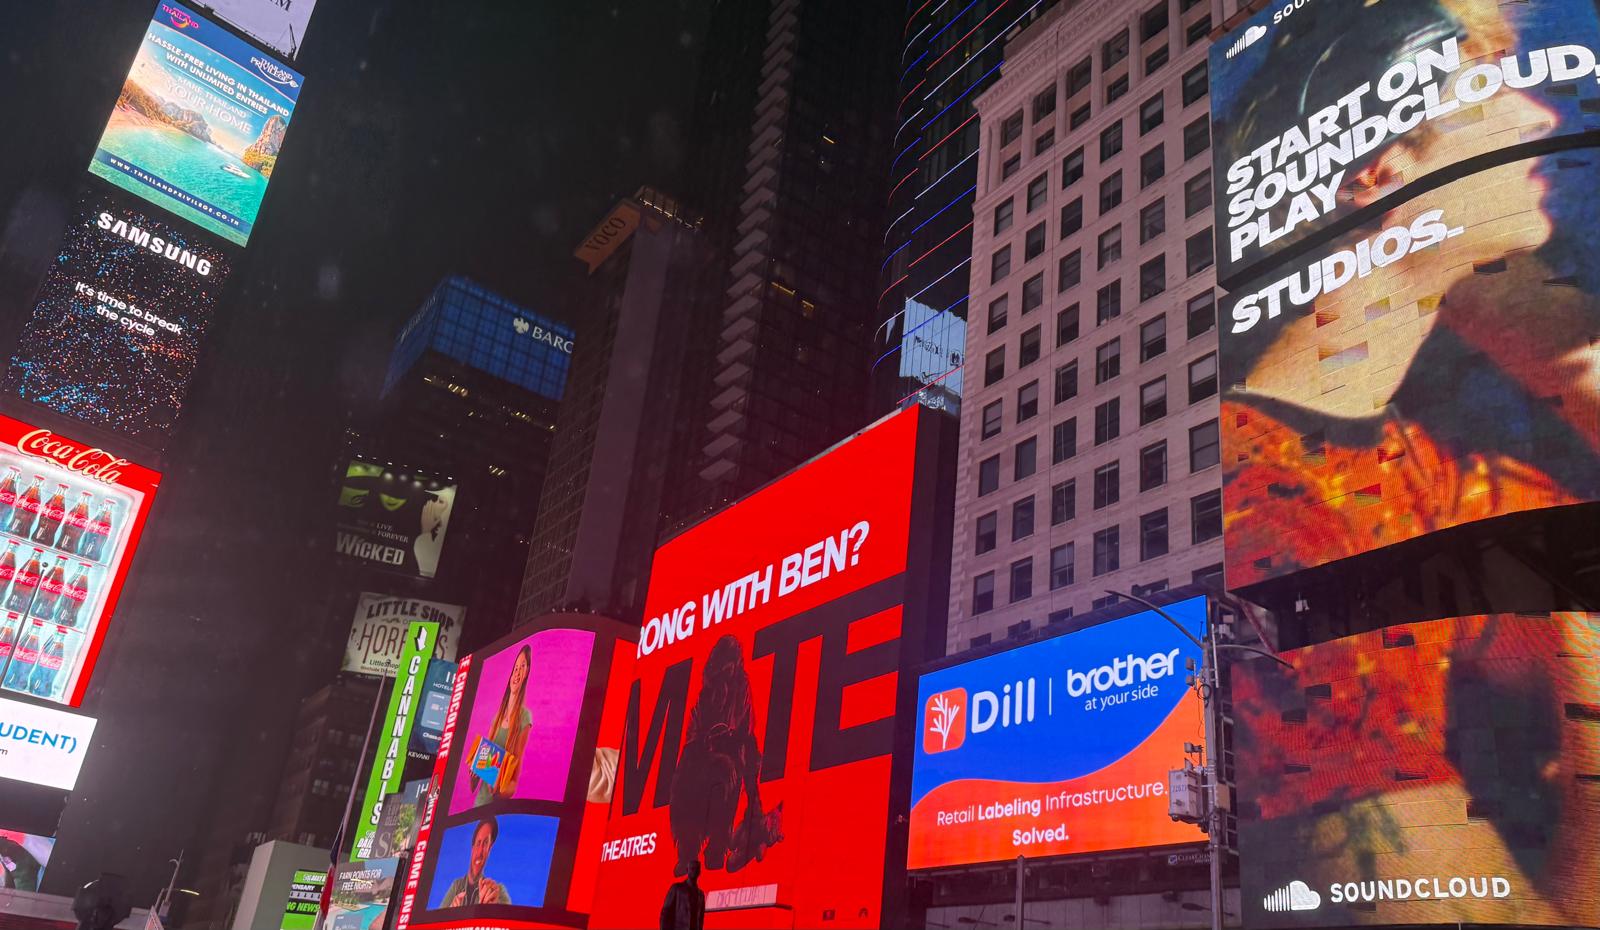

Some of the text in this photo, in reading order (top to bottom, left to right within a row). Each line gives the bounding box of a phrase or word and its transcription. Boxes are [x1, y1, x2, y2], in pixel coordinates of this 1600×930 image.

[1273, 0, 1310, 24] SOU
[148, 33, 290, 117] HASSLE-FREE LIVING IN THAILAND
[166, 53, 268, 115] WITH UNLIMITED ENTRIES
[208, 104, 253, 134] HOME
[1226, 37, 1460, 194] START ON
[1230, 170, 1346, 263] PLAY
[97, 212, 213, 276] SAMSUNG
[1232, 209, 1464, 333] STUDIOS.
[75, 281, 183, 335] It's time to break
[96, 304, 155, 336] the cycle
[532, 326, 574, 354] BARC
[17, 429, 131, 484] Coca-Cola
[702, 565, 773, 629] WITH
[778, 520, 870, 597] BEN?
[367, 601, 455, 632] LITTLE SHOP
[1066, 648, 1179, 698] brother
[438, 671, 467, 759] CHOCOLATE
[971, 677, 1035, 734] Dill
[1085, 684, 1159, 712] at your side
[0, 722, 77, 754] UDENT)
[371, 655, 422, 825] CANNABIS
[937, 780, 1168, 827] Retail Labeling Infrastructure.
[600, 832, 657, 863] THEATRES
[1012, 823, 1069, 846] Solved.
[341, 882, 354, 891] FREE
[351, 870, 370, 880] POINTS
[370, 868, 382, 878] FOR
[407, 840, 427, 889] COME
[1330, 877, 1511, 903] SOUNDCLOUD
